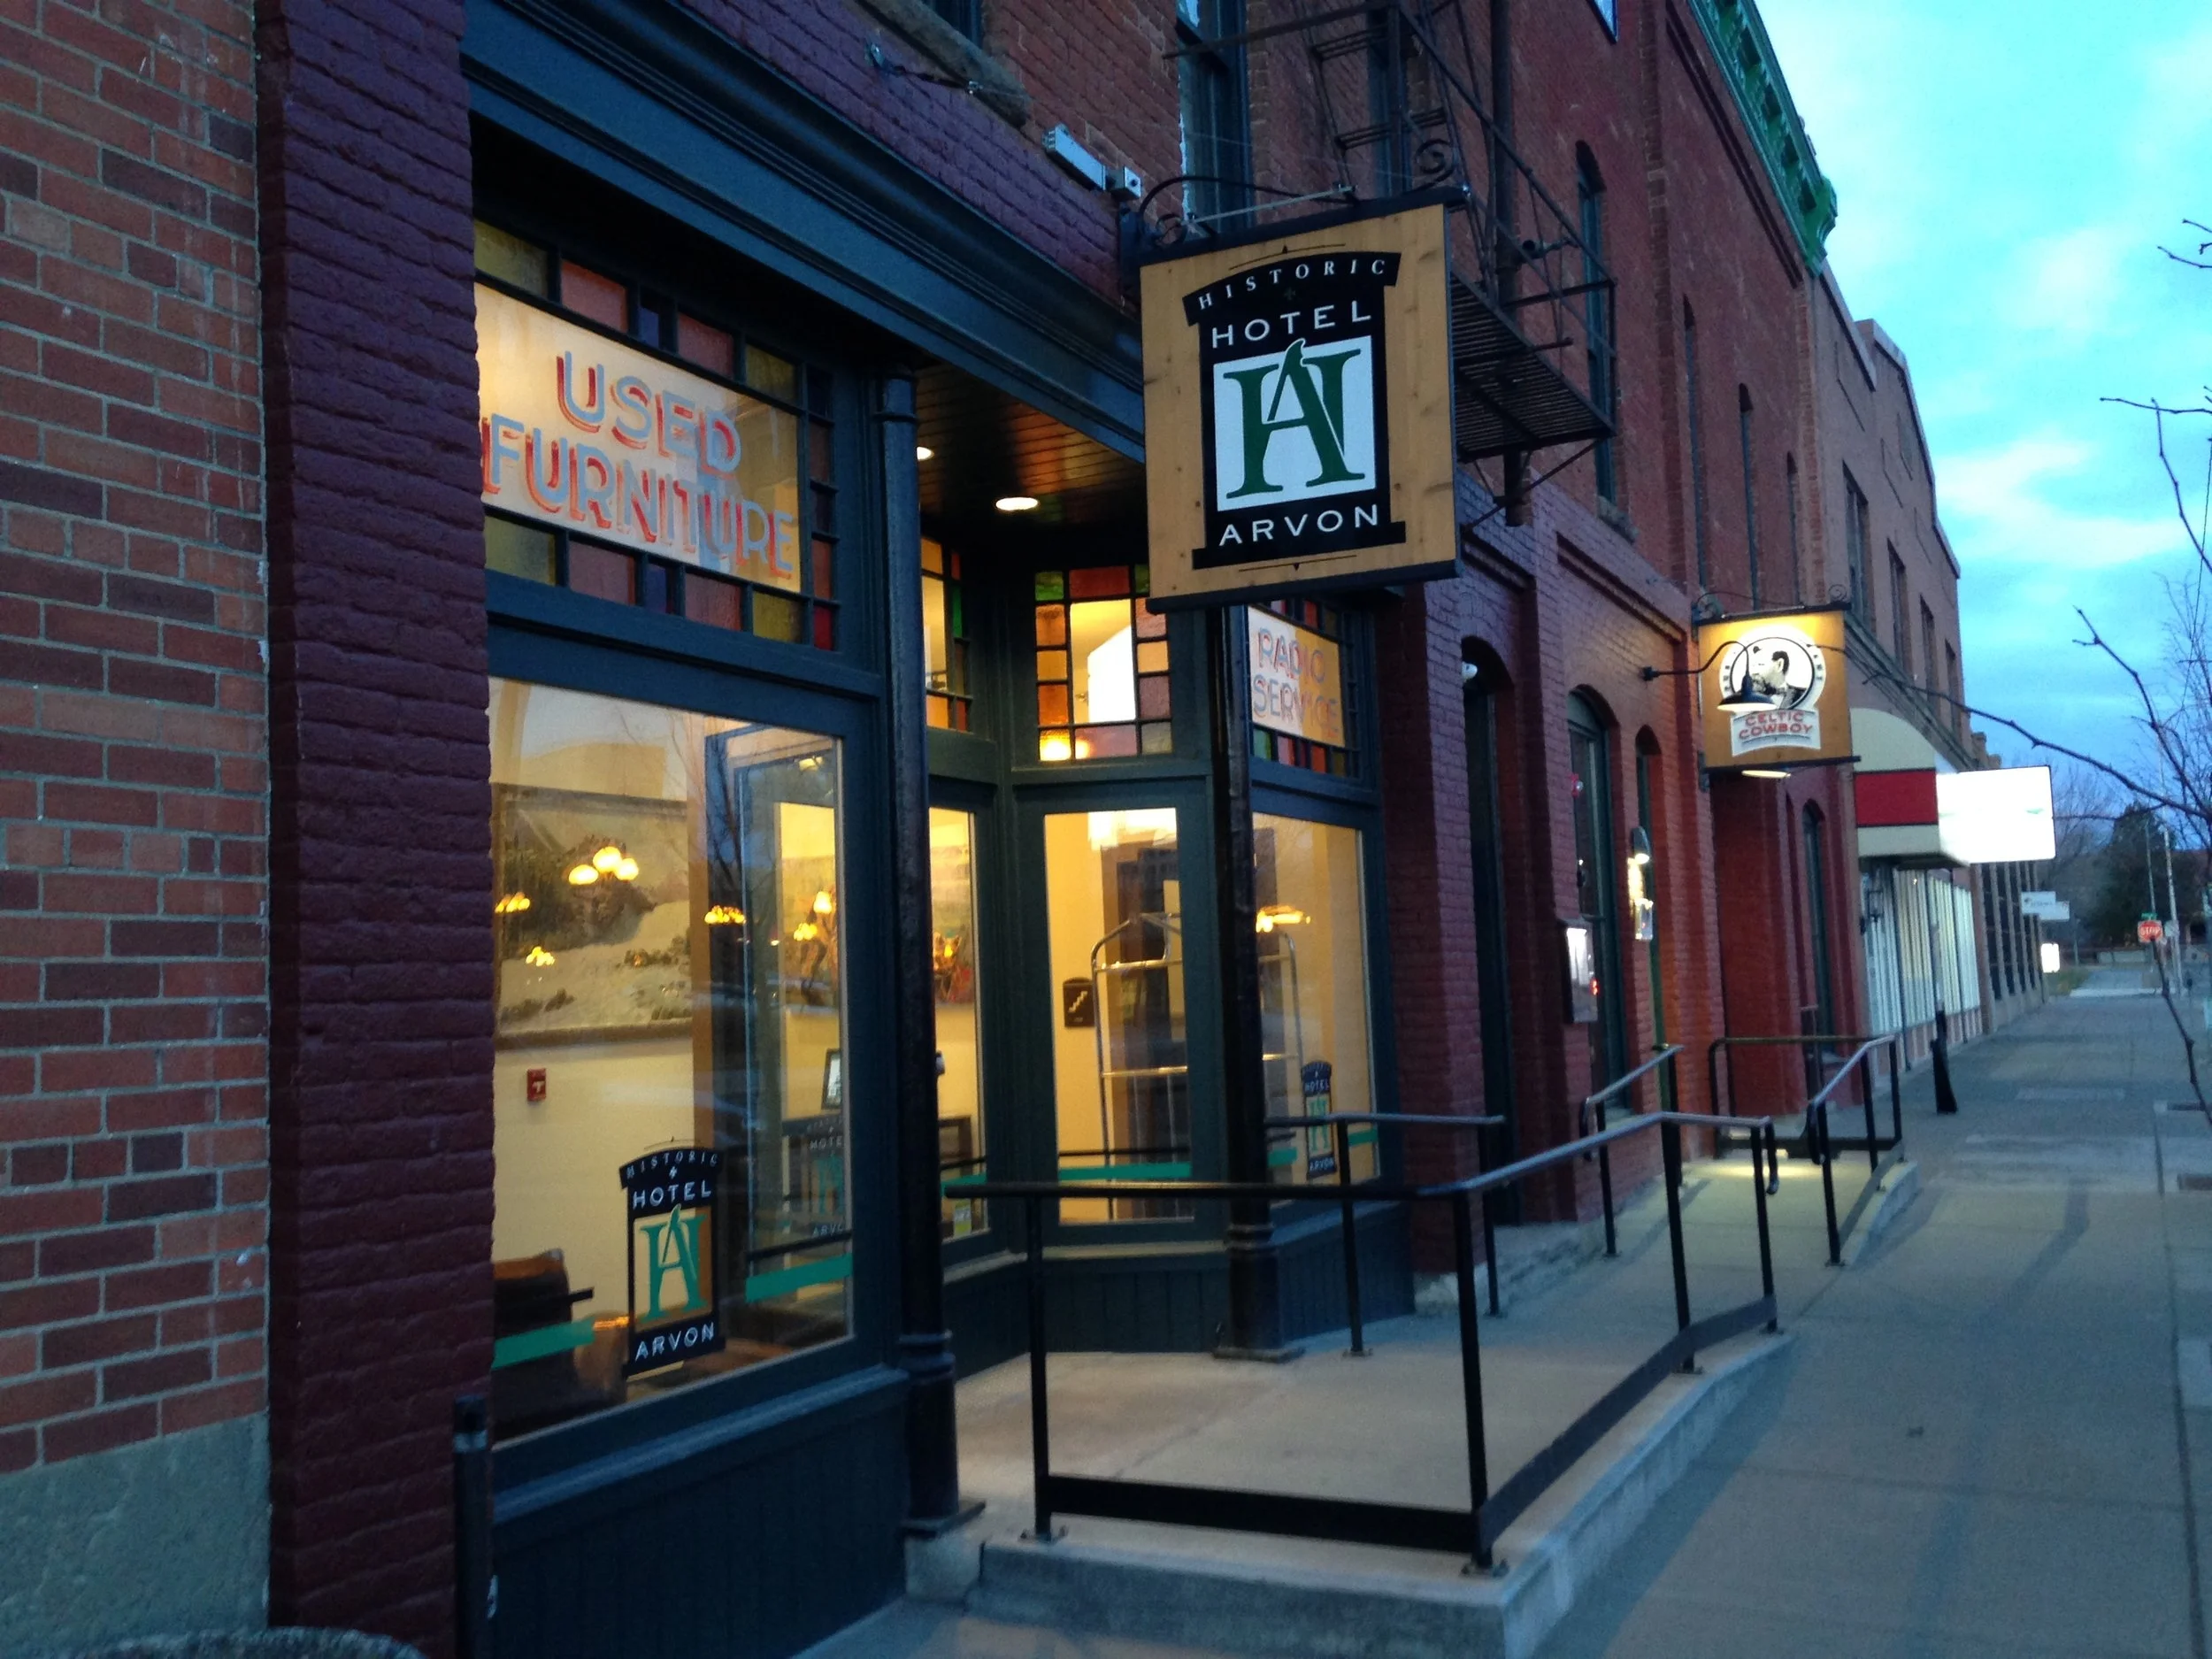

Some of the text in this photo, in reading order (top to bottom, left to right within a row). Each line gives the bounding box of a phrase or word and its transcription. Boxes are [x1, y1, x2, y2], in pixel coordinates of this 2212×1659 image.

[1198, 258, 1386, 311] HISTORIC
[1211, 299, 1372, 349] HOTEL
[556, 350, 742, 479] USED
[481, 412, 795, 580] FURNITURE
[1218, 503, 1379, 548] ARVON
[1257, 626, 1326, 684] RADIO
[1253, 673, 1340, 737] SERVICE
[1745, 710, 1804, 726] CELTIC
[1739, 723, 1813, 740] COWBOY
[626, 1150, 718, 1179] HISTORIC
[632, 1179, 712, 1210] HOTEL
[634, 1322, 715, 1362] ARVON
